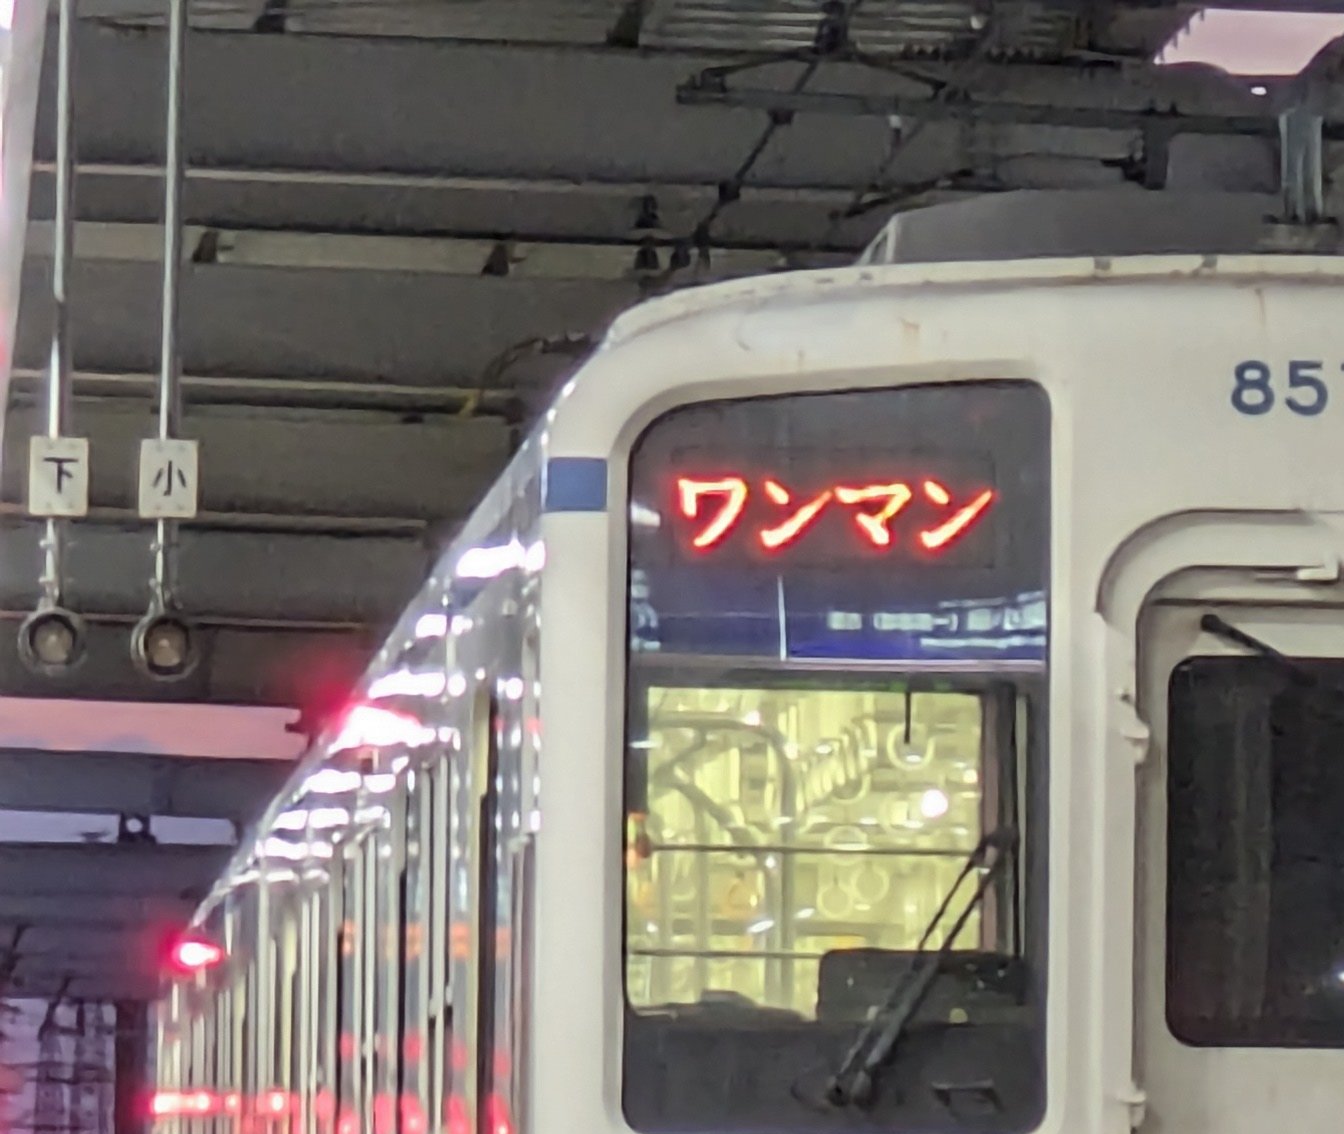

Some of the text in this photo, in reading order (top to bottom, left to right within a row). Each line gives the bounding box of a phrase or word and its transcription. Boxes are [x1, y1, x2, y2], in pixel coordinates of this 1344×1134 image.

[43, 457, 79, 493] 下
[152, 460, 186, 496] 小
[677, 477, 992, 549] ワンマン
